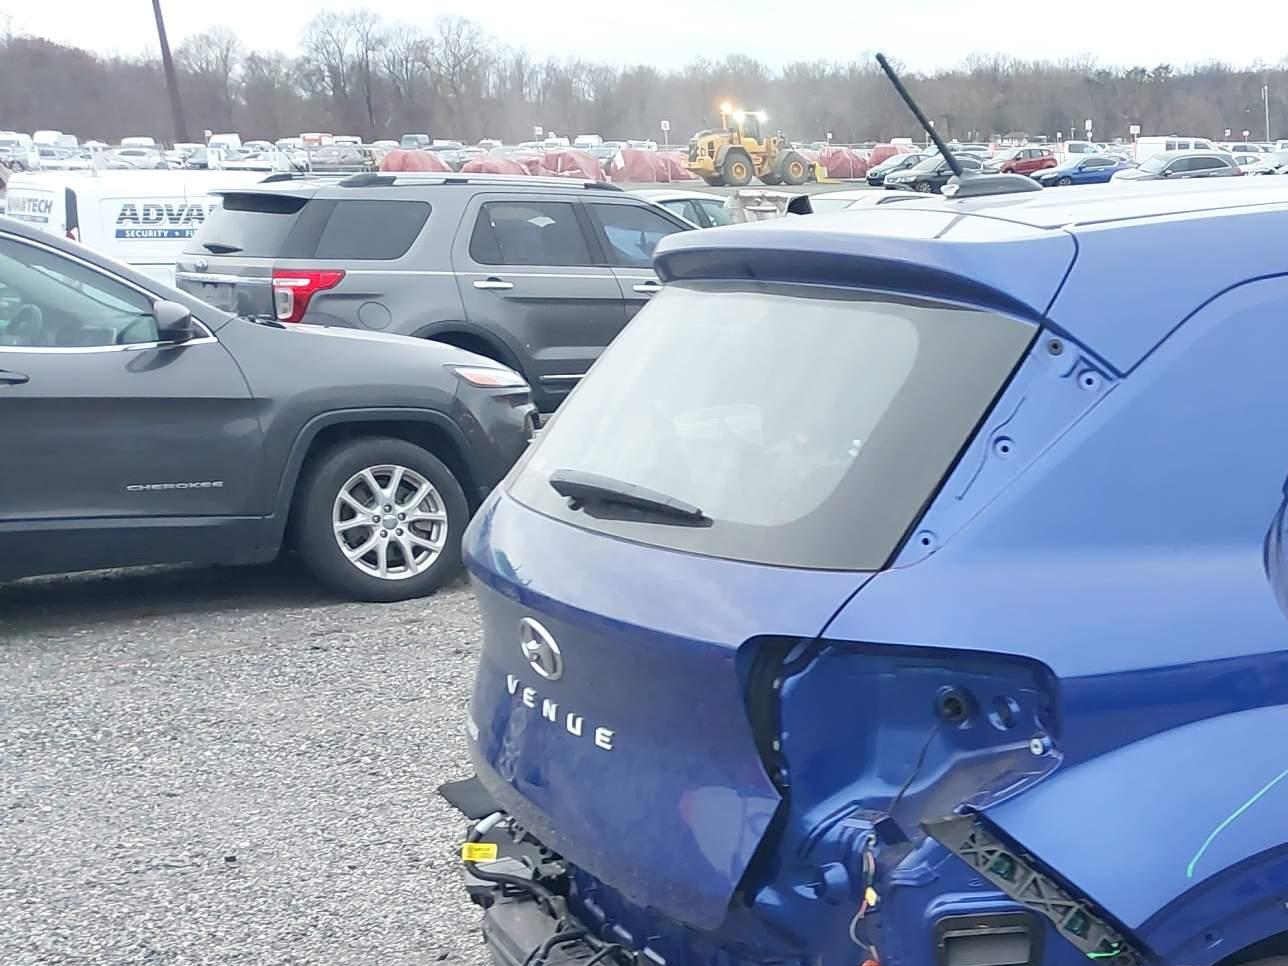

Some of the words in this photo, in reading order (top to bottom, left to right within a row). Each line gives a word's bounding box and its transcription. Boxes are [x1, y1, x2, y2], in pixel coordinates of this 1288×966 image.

[115, 203, 214, 225] ADVA
[125, 229, 168, 238] SECURITY
[185, 229, 195, 238] FI
[126, 481, 224, 491] CHEROKEE
[507, 674, 615, 751] VENUE
